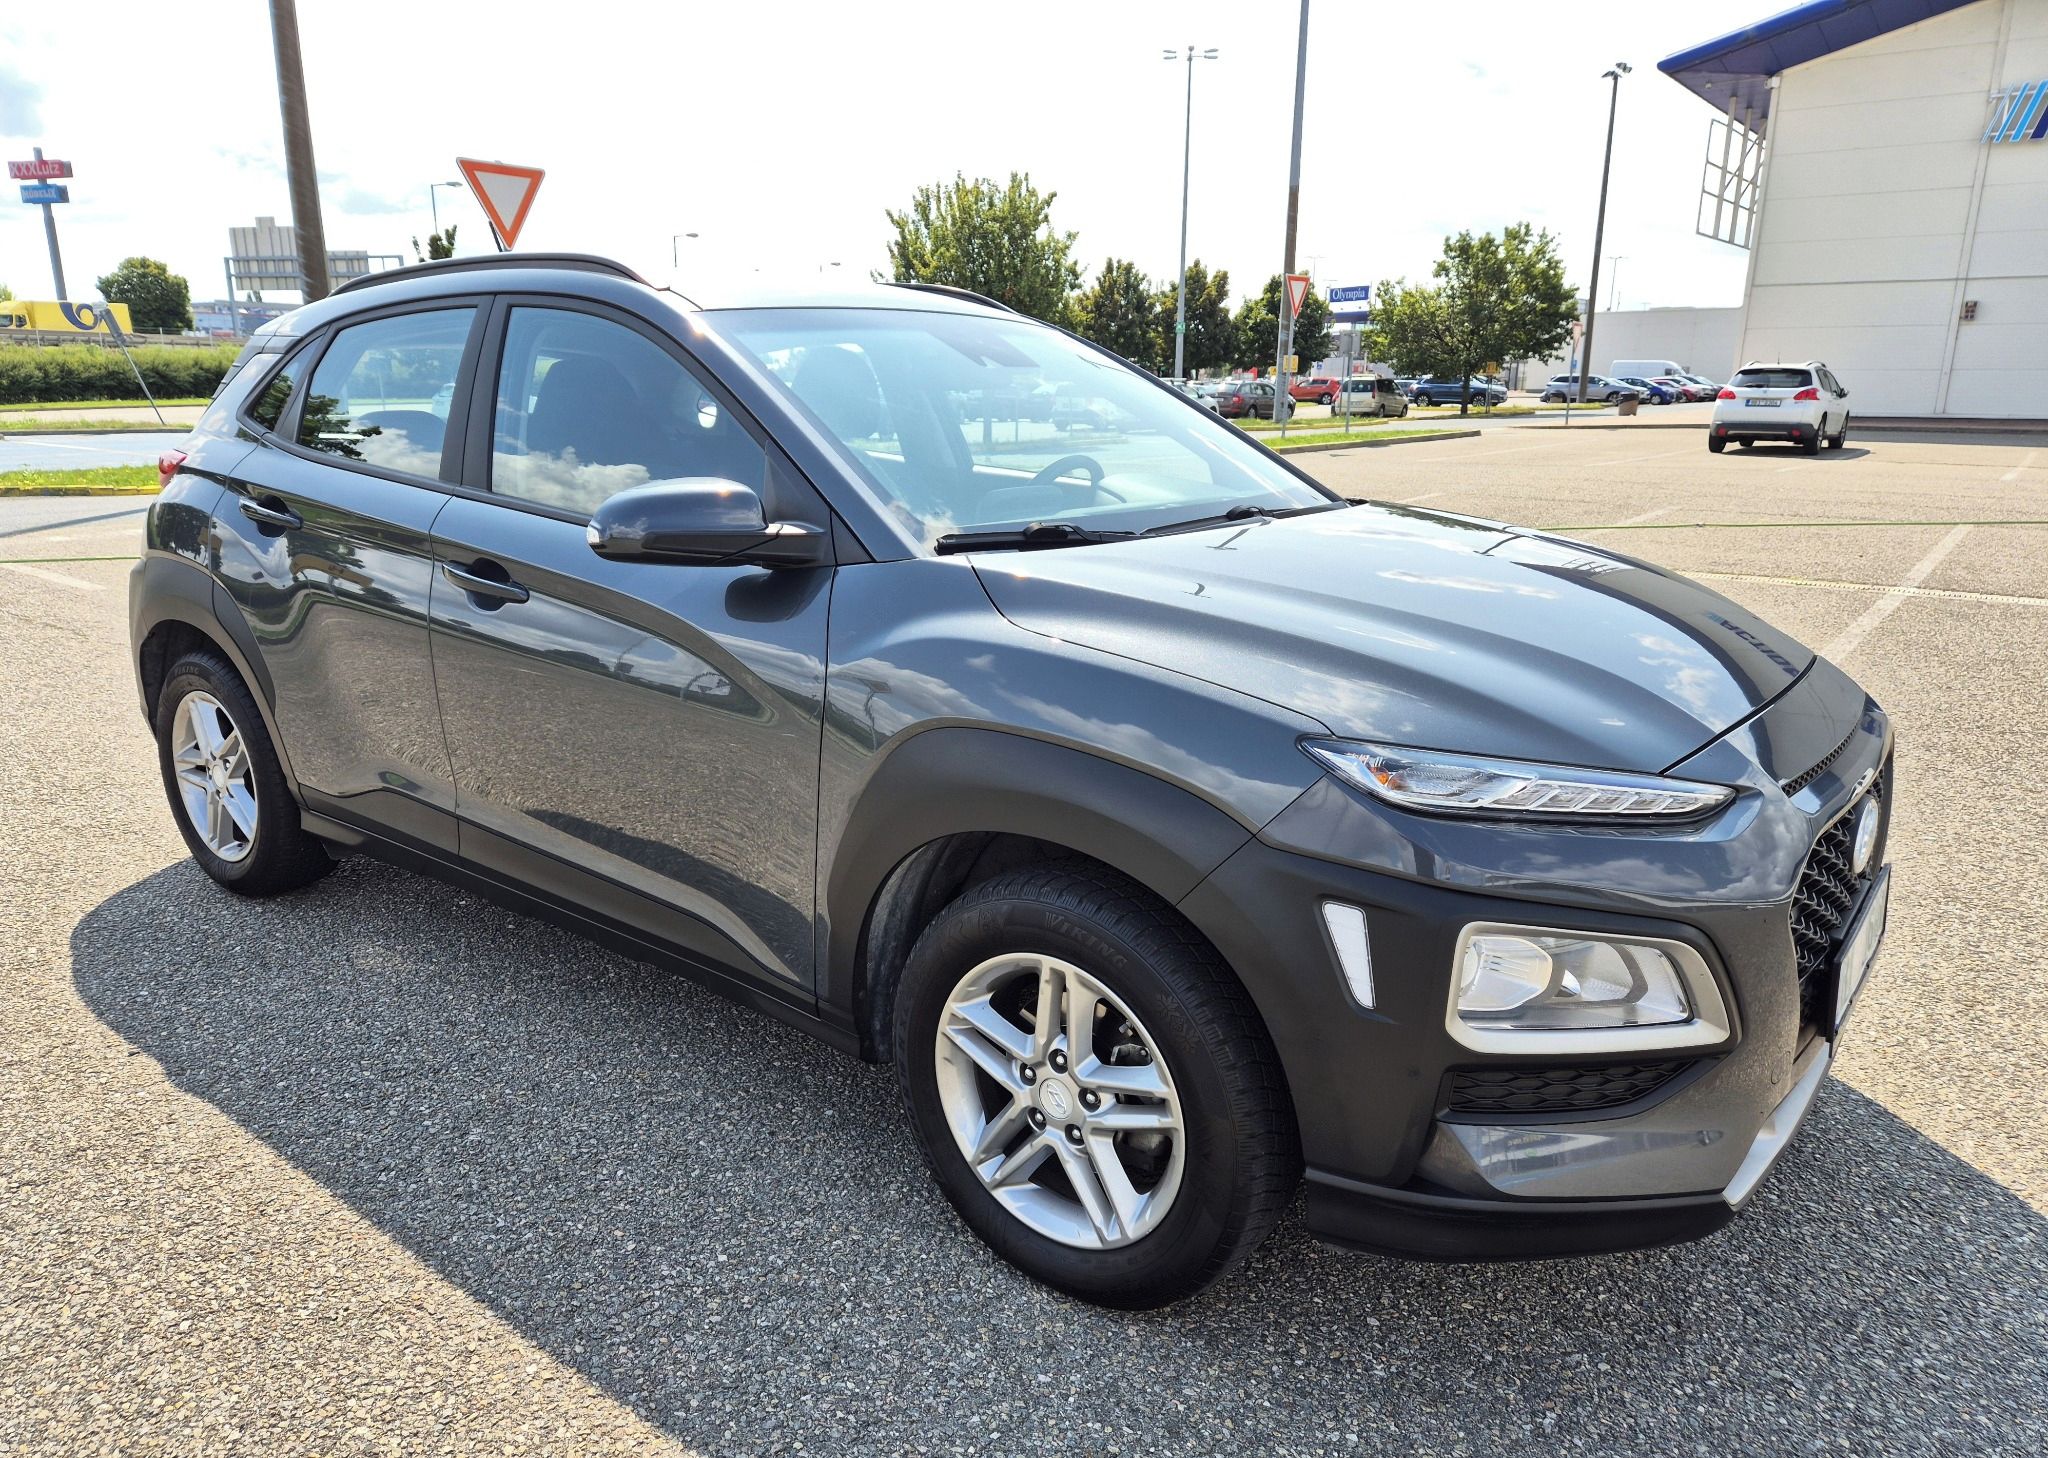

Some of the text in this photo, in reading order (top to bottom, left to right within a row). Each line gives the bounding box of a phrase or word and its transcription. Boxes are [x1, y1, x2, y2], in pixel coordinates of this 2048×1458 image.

[11, 161, 61, 176] XXXLutz
[1332, 287, 1365, 301] Olympia
[1044, 911, 1128, 968] VIKING
